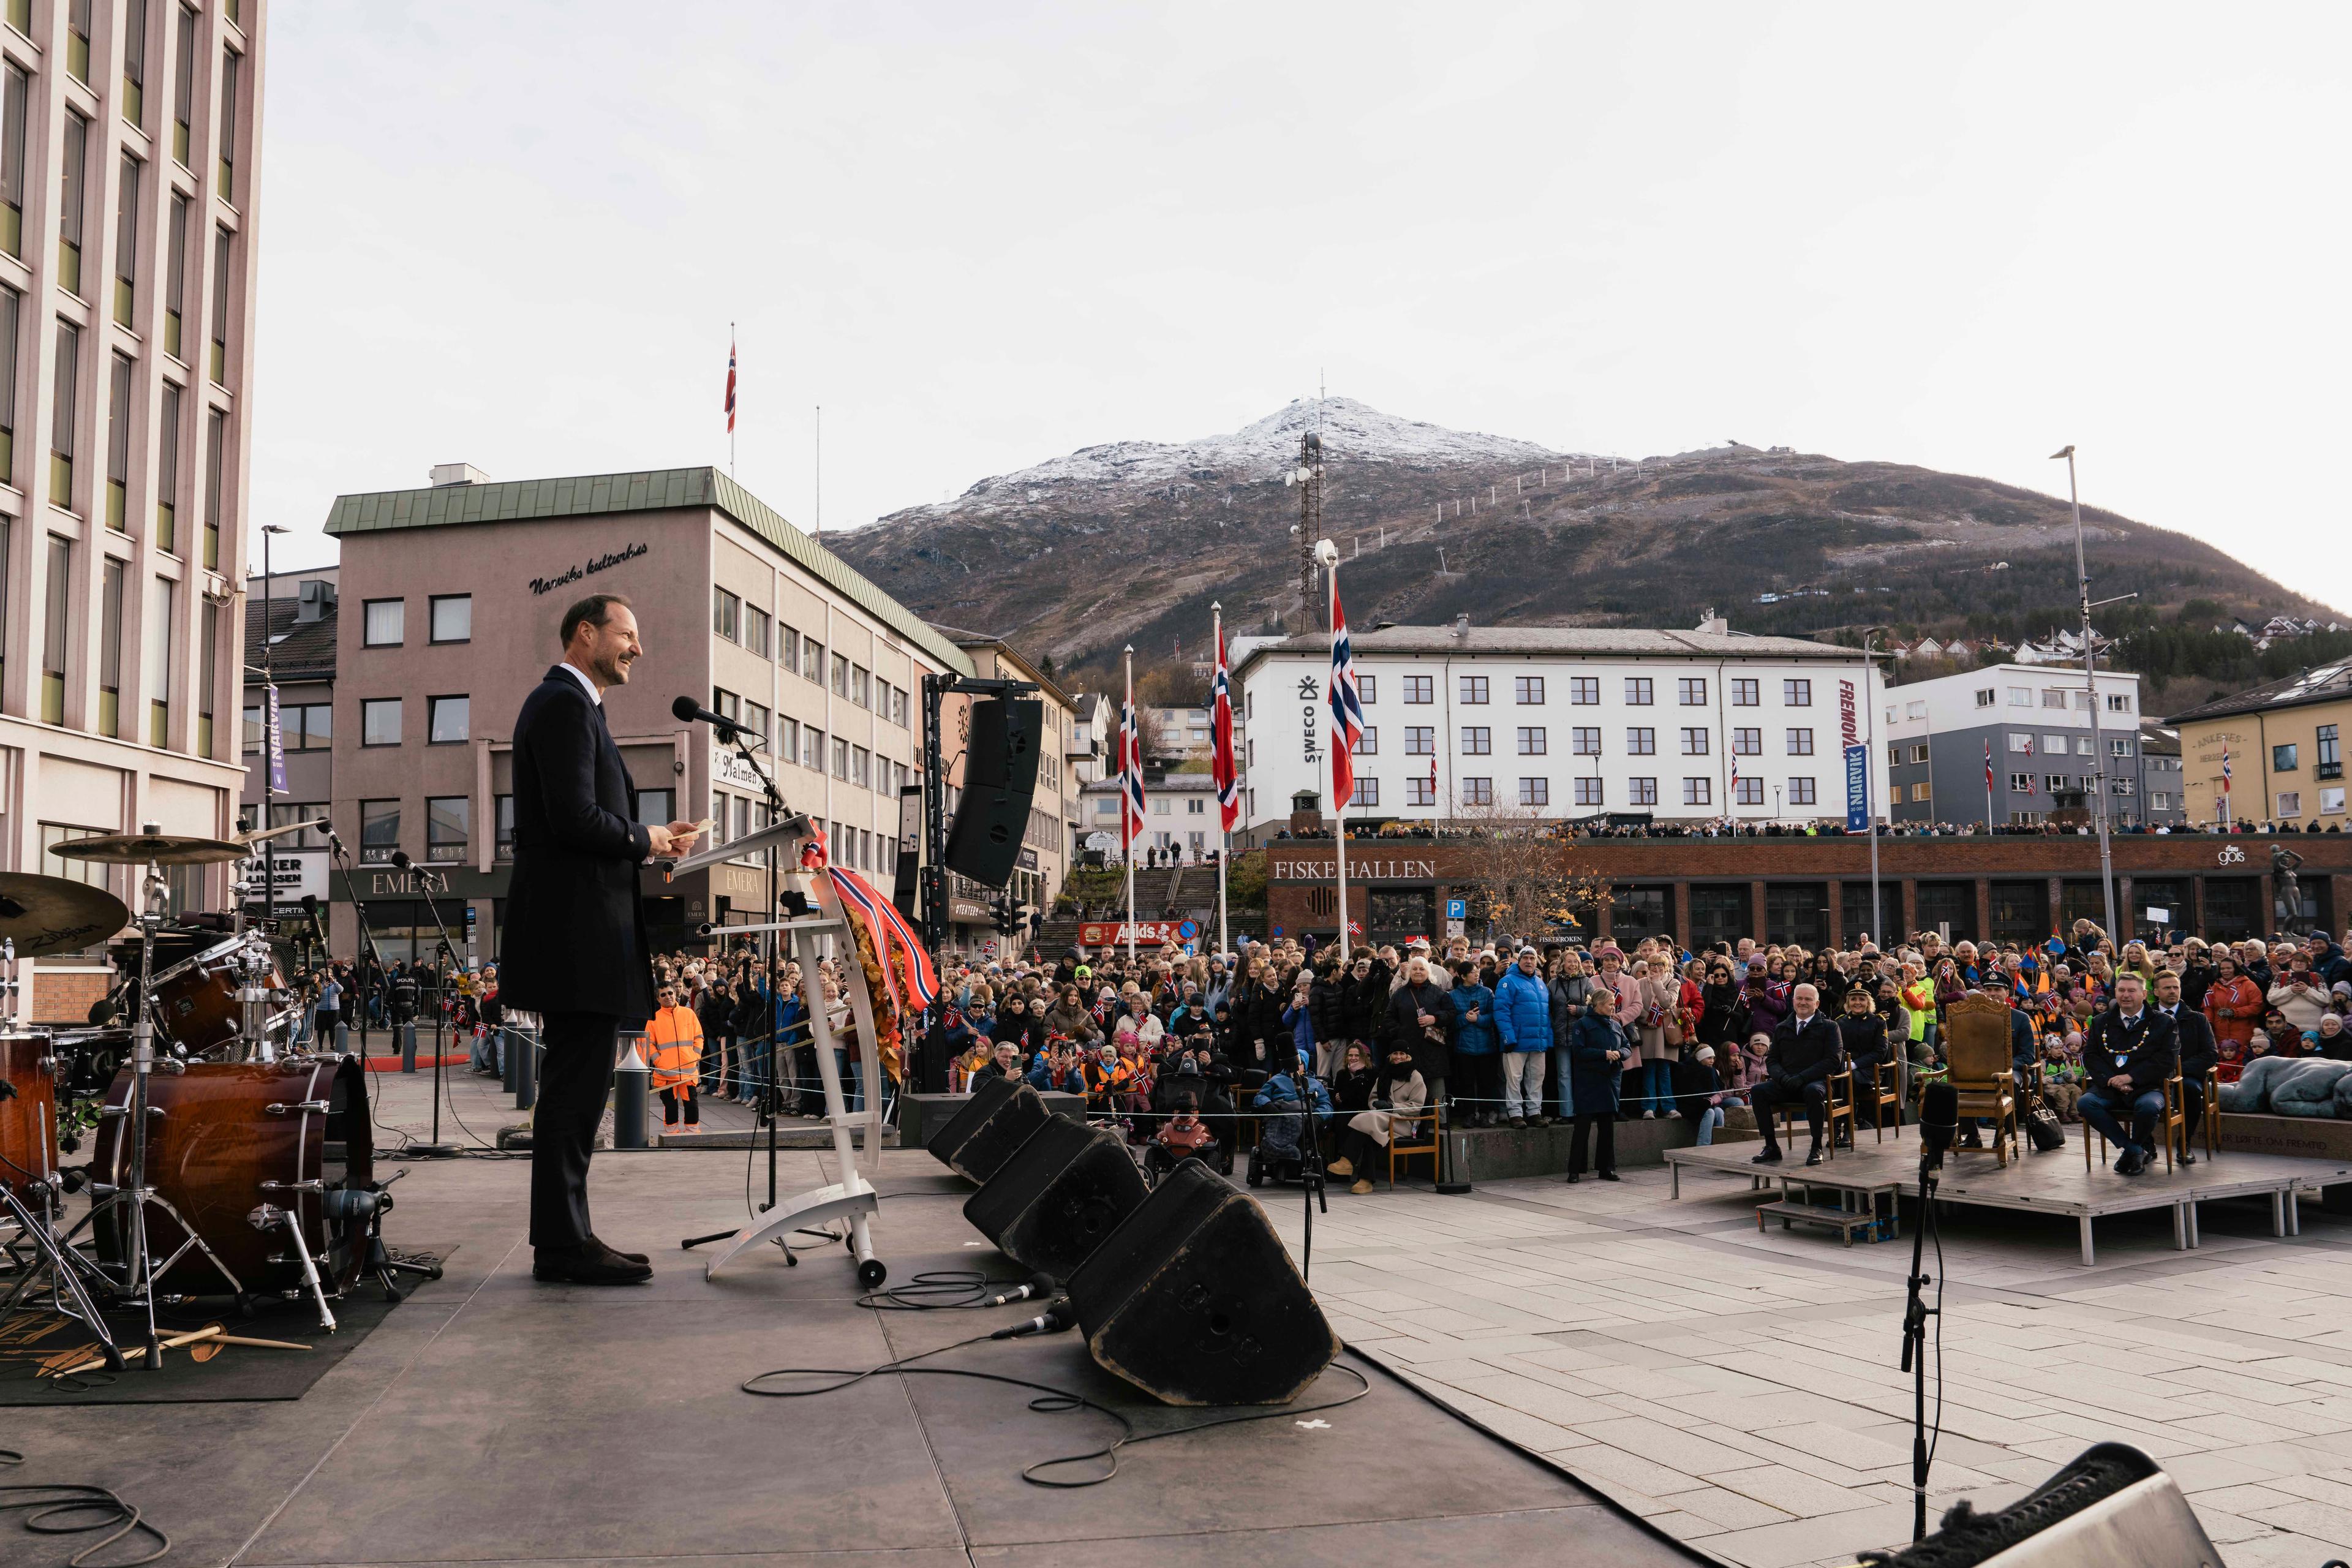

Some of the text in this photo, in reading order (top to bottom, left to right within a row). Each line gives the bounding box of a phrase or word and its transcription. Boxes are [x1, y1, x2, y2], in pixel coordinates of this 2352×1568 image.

[529, 543, 647, 596] Narviks kulturhus
[270, 692, 282, 760] NARVIK
[1839, 679, 1860, 760] FREMOV
[1303, 706, 1316, 763] SWECO
[2197, 733, 2242, 748] ANKENES
[723, 755, 756, 785] Malmen
[1850, 750, 1863, 805] NARVIK
[246, 874, 301, 883] LIUSEN
[726, 870, 759, 893] EMERA
[1273, 861, 1436, 879] FISKEHALLEN
[373, 872, 449, 894] EMERA
[1451, 902, 1460, 916] P
[2286, 1139, 2328, 1150] FREMTID
